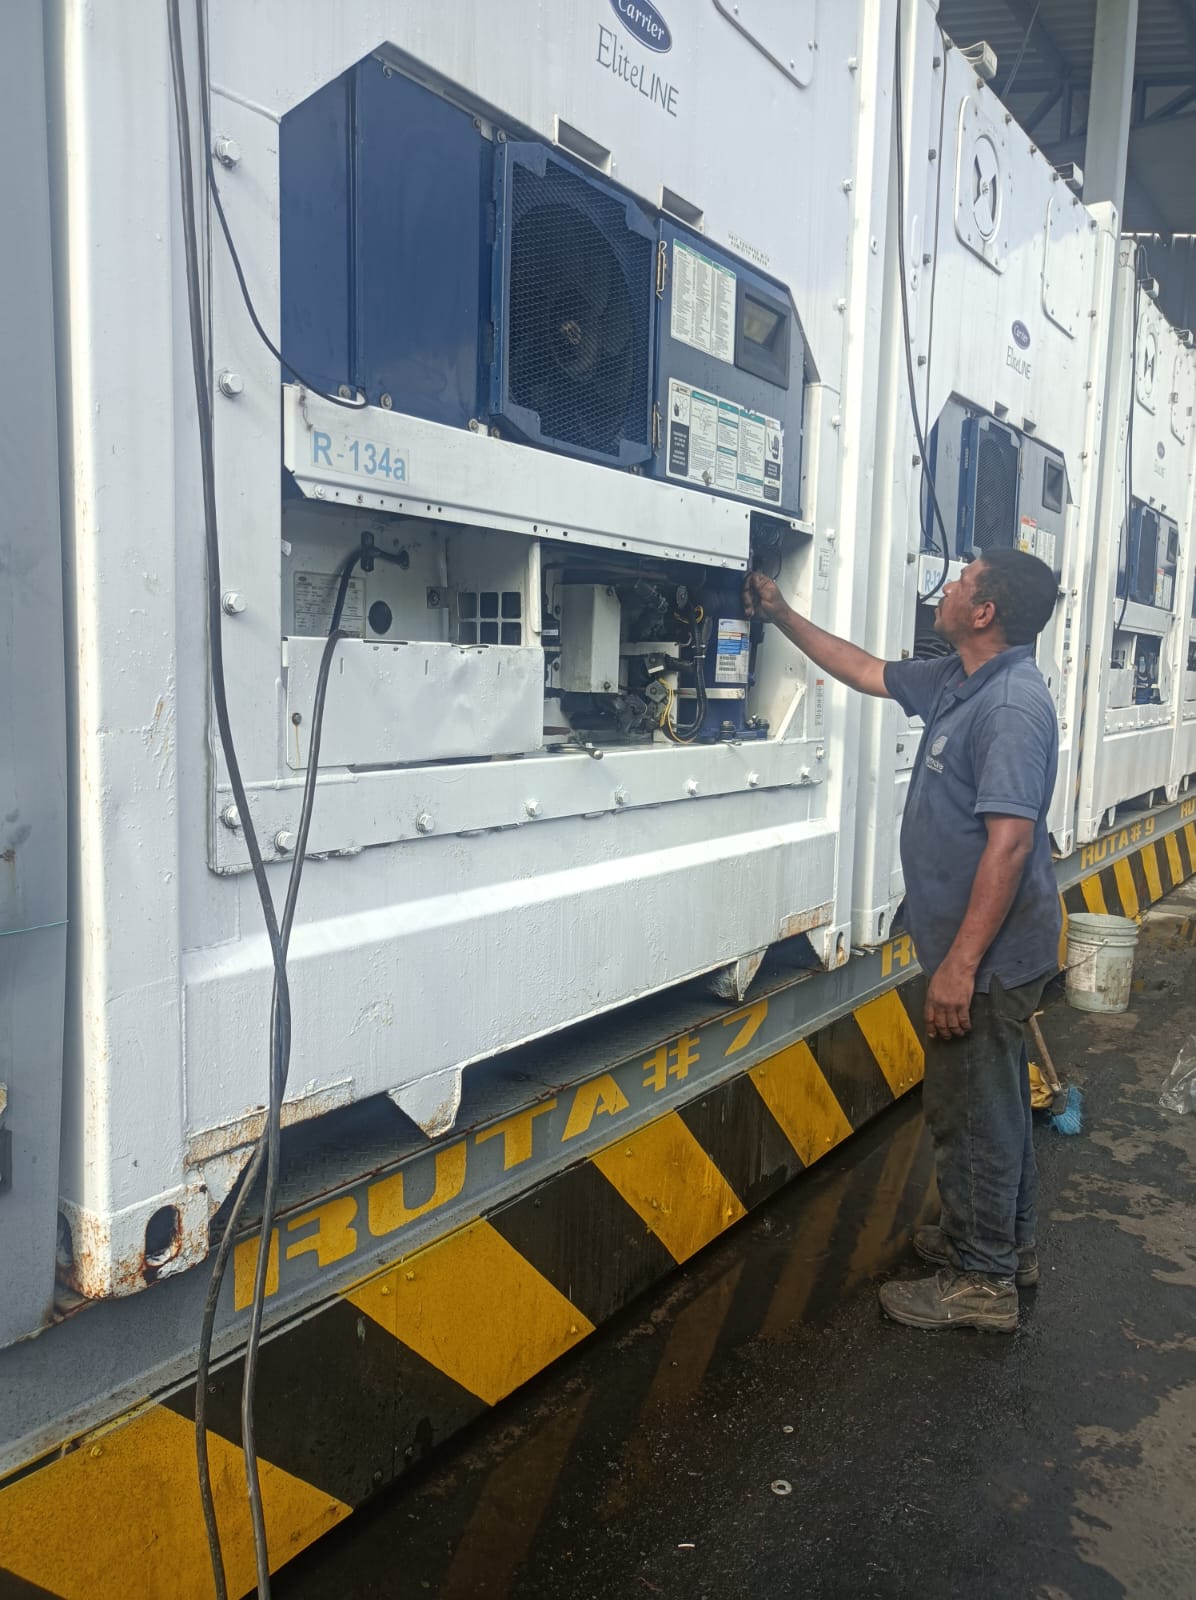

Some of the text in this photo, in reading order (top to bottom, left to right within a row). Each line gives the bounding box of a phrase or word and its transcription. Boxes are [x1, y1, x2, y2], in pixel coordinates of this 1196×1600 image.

[596, 24, 679, 117] EliteLINE
[313, 431, 406, 481] R-134a
[1081, 829, 1128, 870] RUTA
[234, 1074, 630, 1312] RUTA
